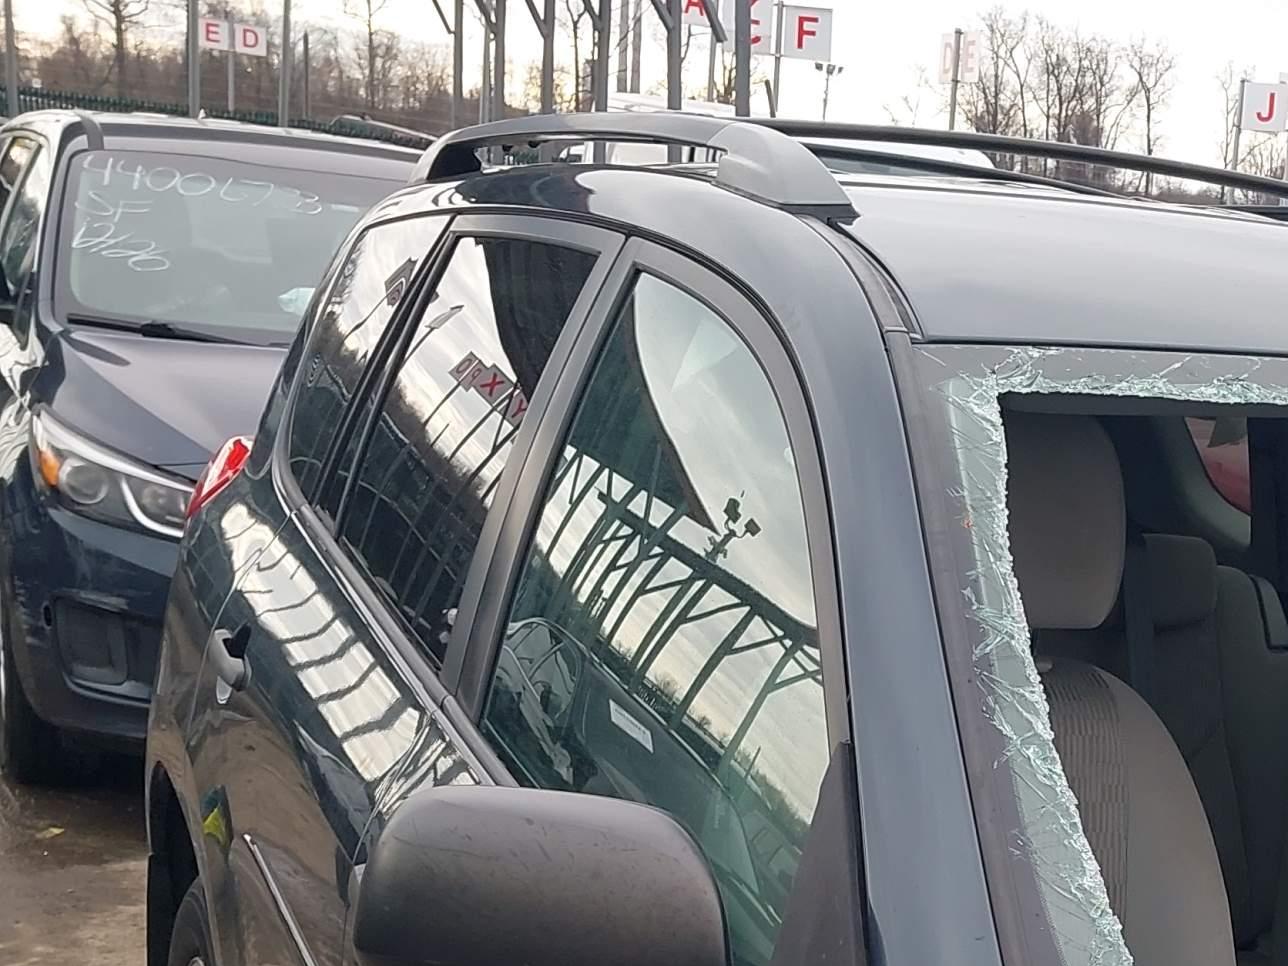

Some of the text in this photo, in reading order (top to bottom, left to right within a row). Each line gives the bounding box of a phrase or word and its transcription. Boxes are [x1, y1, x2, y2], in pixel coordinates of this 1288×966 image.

[206, 22, 220, 43] E
[243, 28, 259, 48] D
[797, 16, 819, 49] F
[1256, 92, 1276, 122] J
